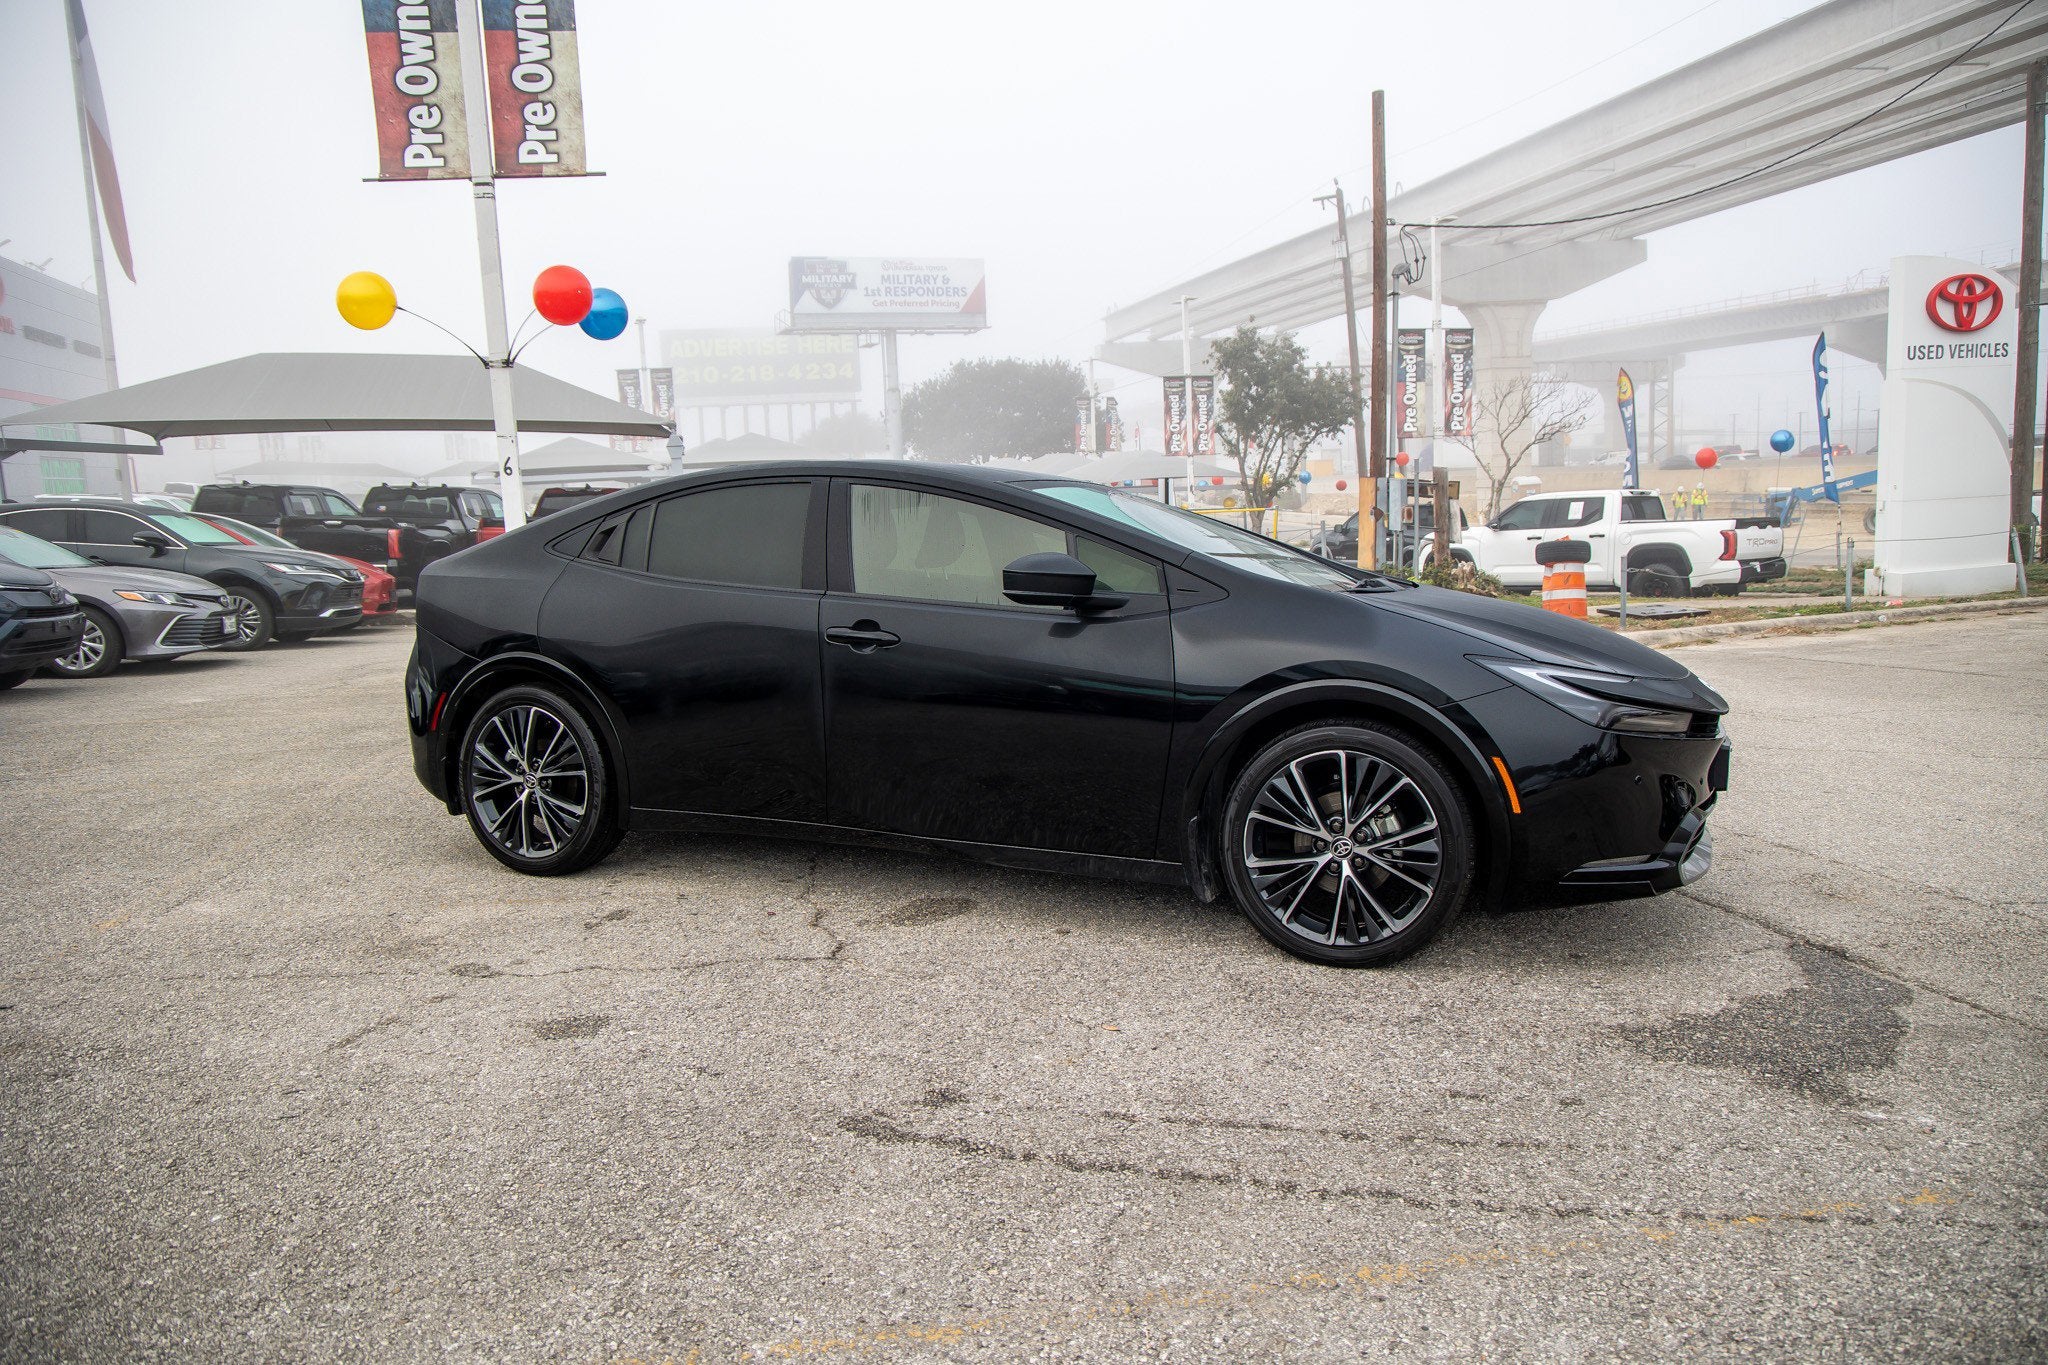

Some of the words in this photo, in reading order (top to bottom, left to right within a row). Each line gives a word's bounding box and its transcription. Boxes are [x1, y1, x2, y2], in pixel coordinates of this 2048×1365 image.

[395, 0, 438, 96] Own
[511, 0, 554, 93] Own
[403, 104, 446, 168] Pre
[518, 102, 559, 164] Pre
[801, 274, 853, 283] MILITARY
[881, 274, 939, 285] MILITARY
[942, 274, 951, 285] &
[863, 286, 881, 297] 1st
[884, 286, 968, 297] RESPONDERS
[871, 299, 887, 307] Get
[889, 299, 929, 307] Preferred
[931, 299, 960, 309] Pricing
[671, 336, 788, 357] ADVERTISE
[801, 335, 853, 354] HERE
[1907, 344, 1944, 360] USED
[1948, 342, 2008, 358] VEHICLES
[1403, 354, 1417, 405] Owned
[1450, 353, 1463, 404] Owned
[1168, 394, 1181, 431] Owned
[1196, 394, 1208, 431] Owned
[1403, 407, 1417, 432] Pre
[1450, 406, 1463, 430] Pre
[1170, 433, 1181, 451] Pre
[1198, 432, 1209, 450] Pre
[503, 456, 513, 476] 6
